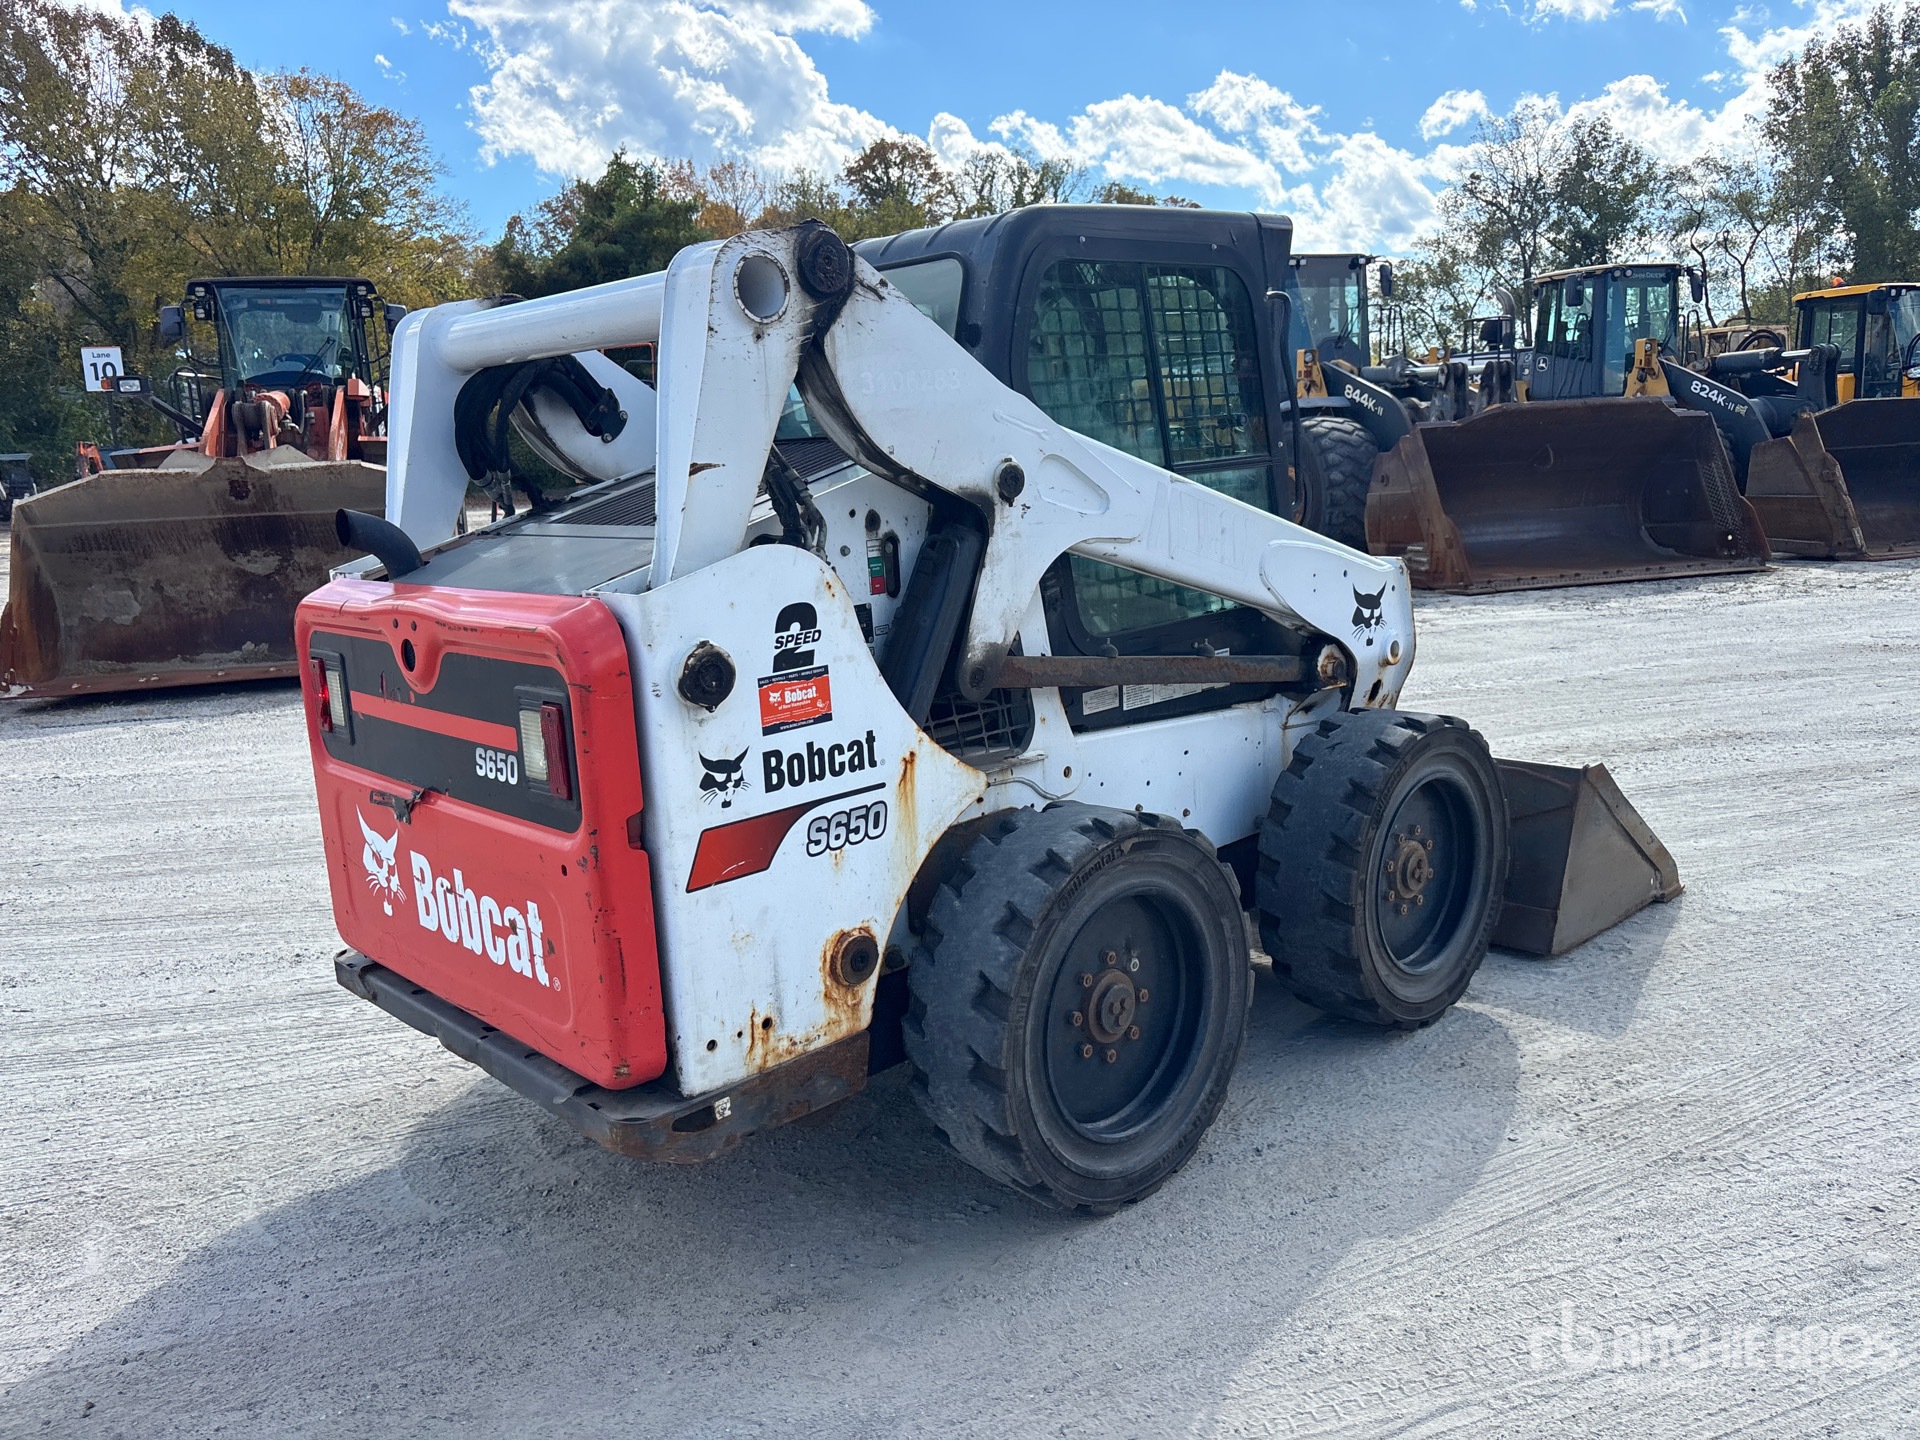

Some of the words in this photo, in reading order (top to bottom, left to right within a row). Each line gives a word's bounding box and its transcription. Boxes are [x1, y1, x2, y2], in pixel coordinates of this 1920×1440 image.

[90, 361, 117, 381] 10
[1344, 384, 1384, 417] 844K-II
[1690, 380, 1735, 412] 824K-II
[772, 602, 818, 673] 2
[774, 629, 822, 650] SPEED
[784, 686, 817, 704] Bobcat
[475, 747, 518, 786] S650
[762, 730, 878, 794] Bobcat
[806, 800, 888, 858] S650
[410, 850, 550, 988] Bobcat
